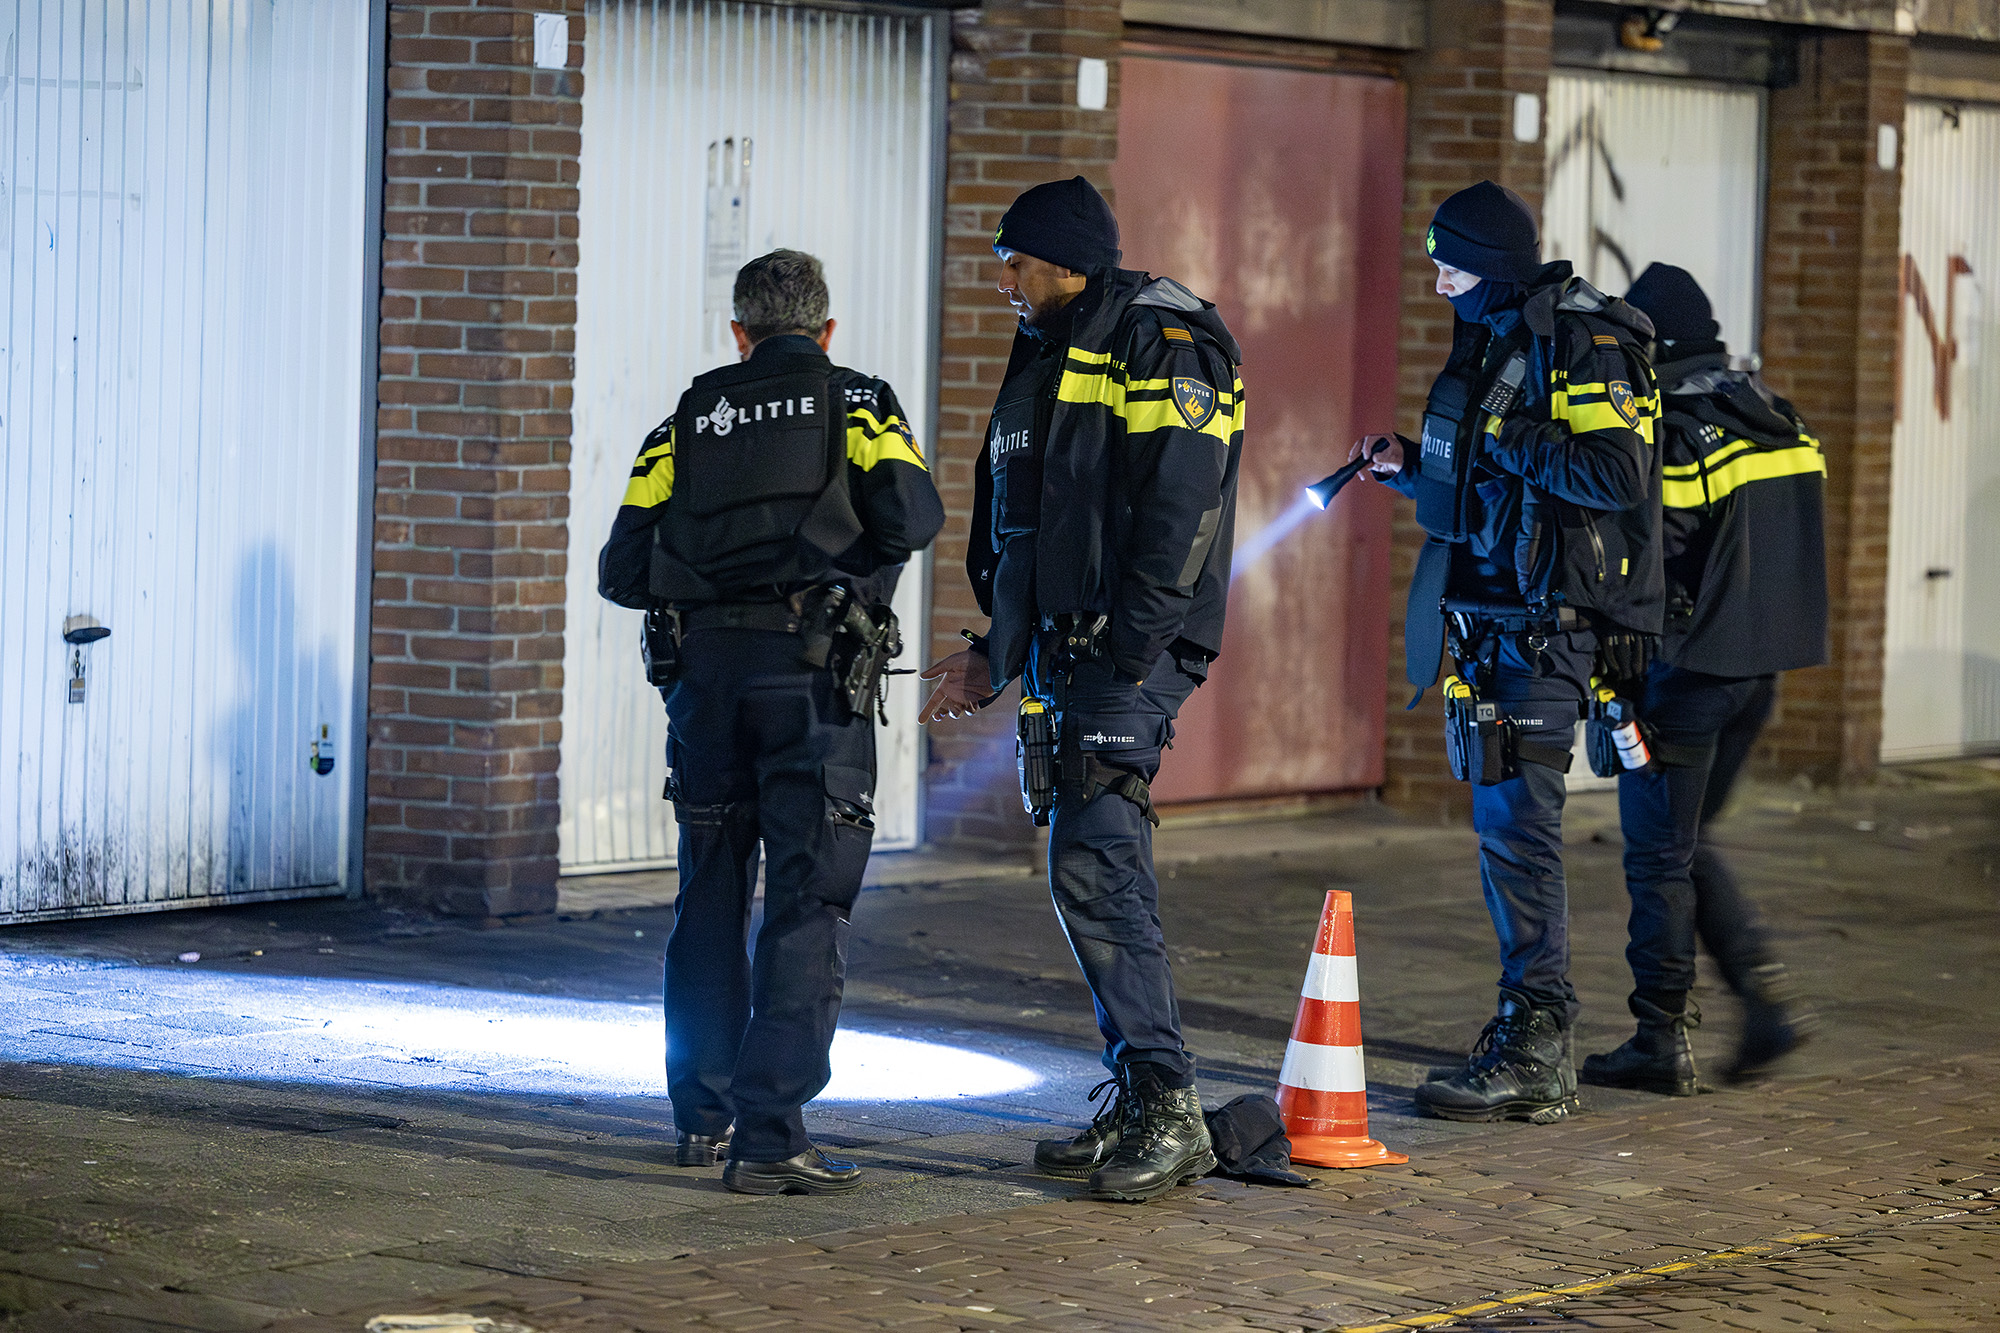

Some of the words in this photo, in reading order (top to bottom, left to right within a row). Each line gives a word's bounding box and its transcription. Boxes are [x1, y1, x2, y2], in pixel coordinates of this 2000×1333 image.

[1178, 382, 1211, 398] POLITIE
[695, 395, 815, 437] POLITIE
[1092, 733, 1126, 745] POLITIE
